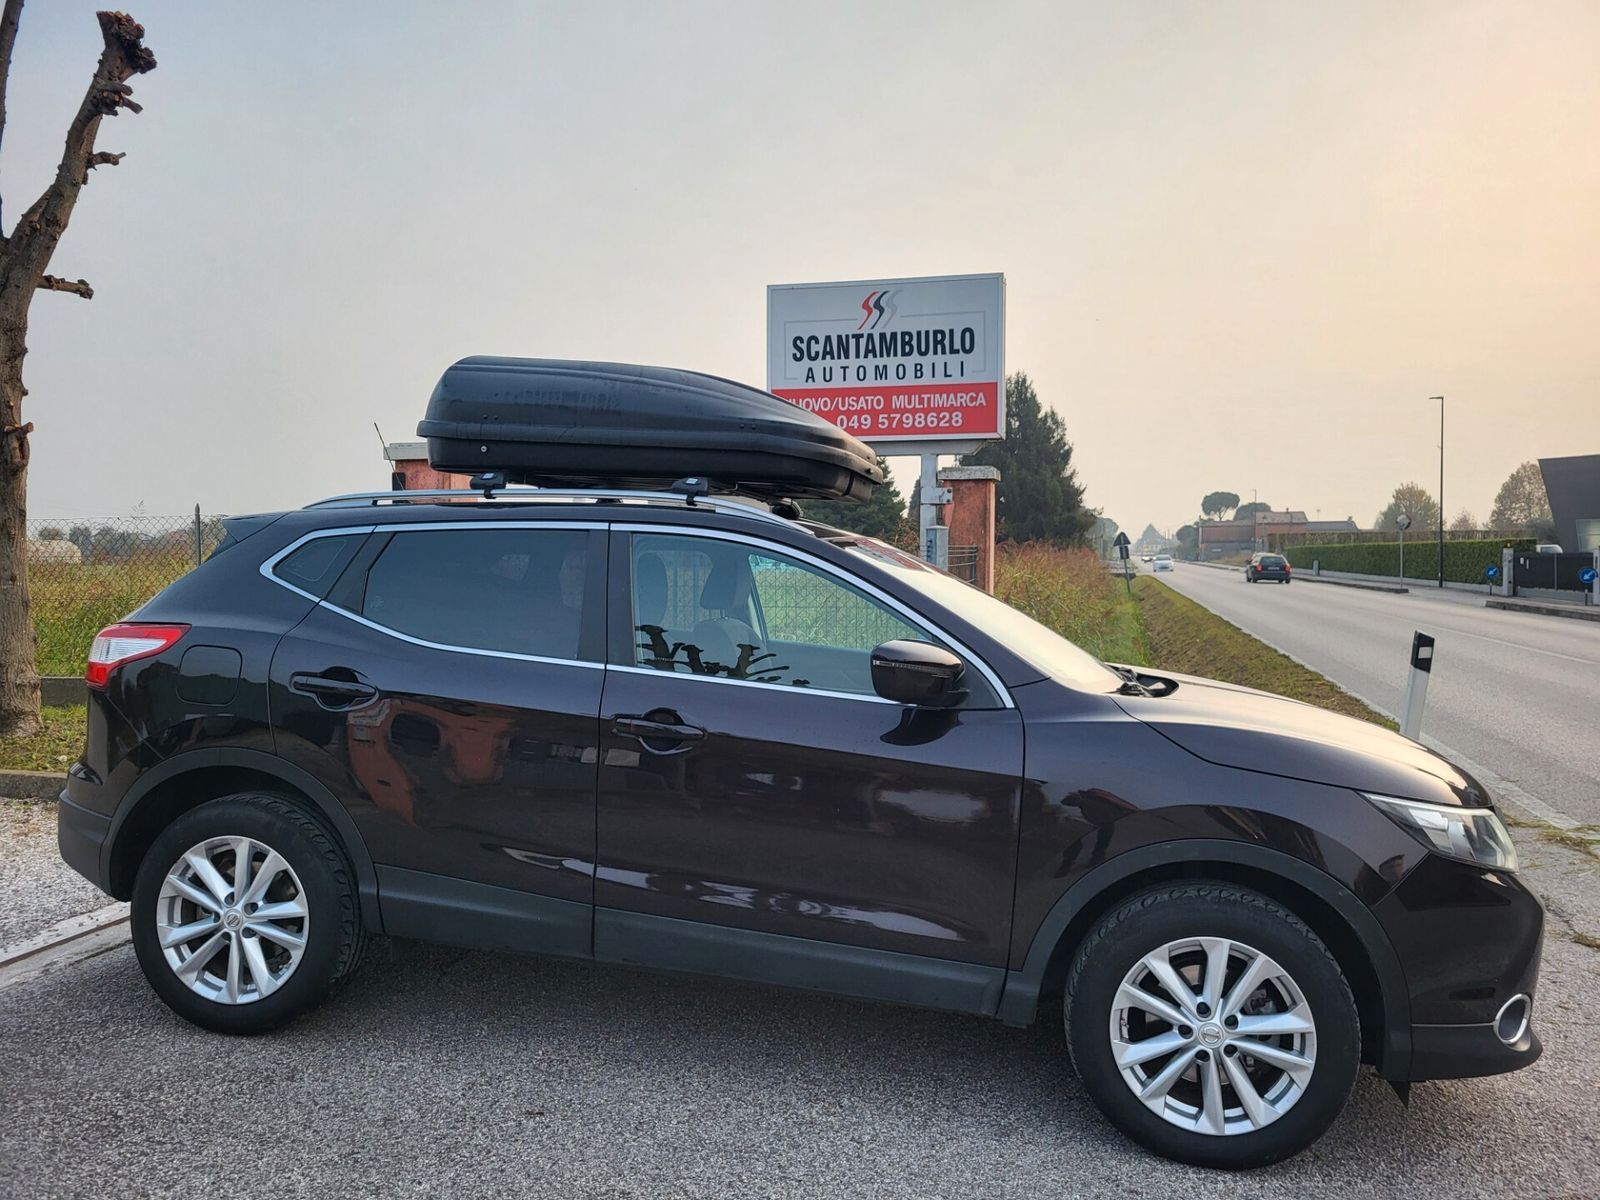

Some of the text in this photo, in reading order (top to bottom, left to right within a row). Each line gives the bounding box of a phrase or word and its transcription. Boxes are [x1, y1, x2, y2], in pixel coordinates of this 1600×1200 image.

[792, 327, 976, 362] SCANTAMBURLO
[805, 361, 965, 383] AUTOMOBILI
[787, 391, 987, 412] OVO/USATO MULTIMARCA
[836, 412, 963, 430] 049 5798628
